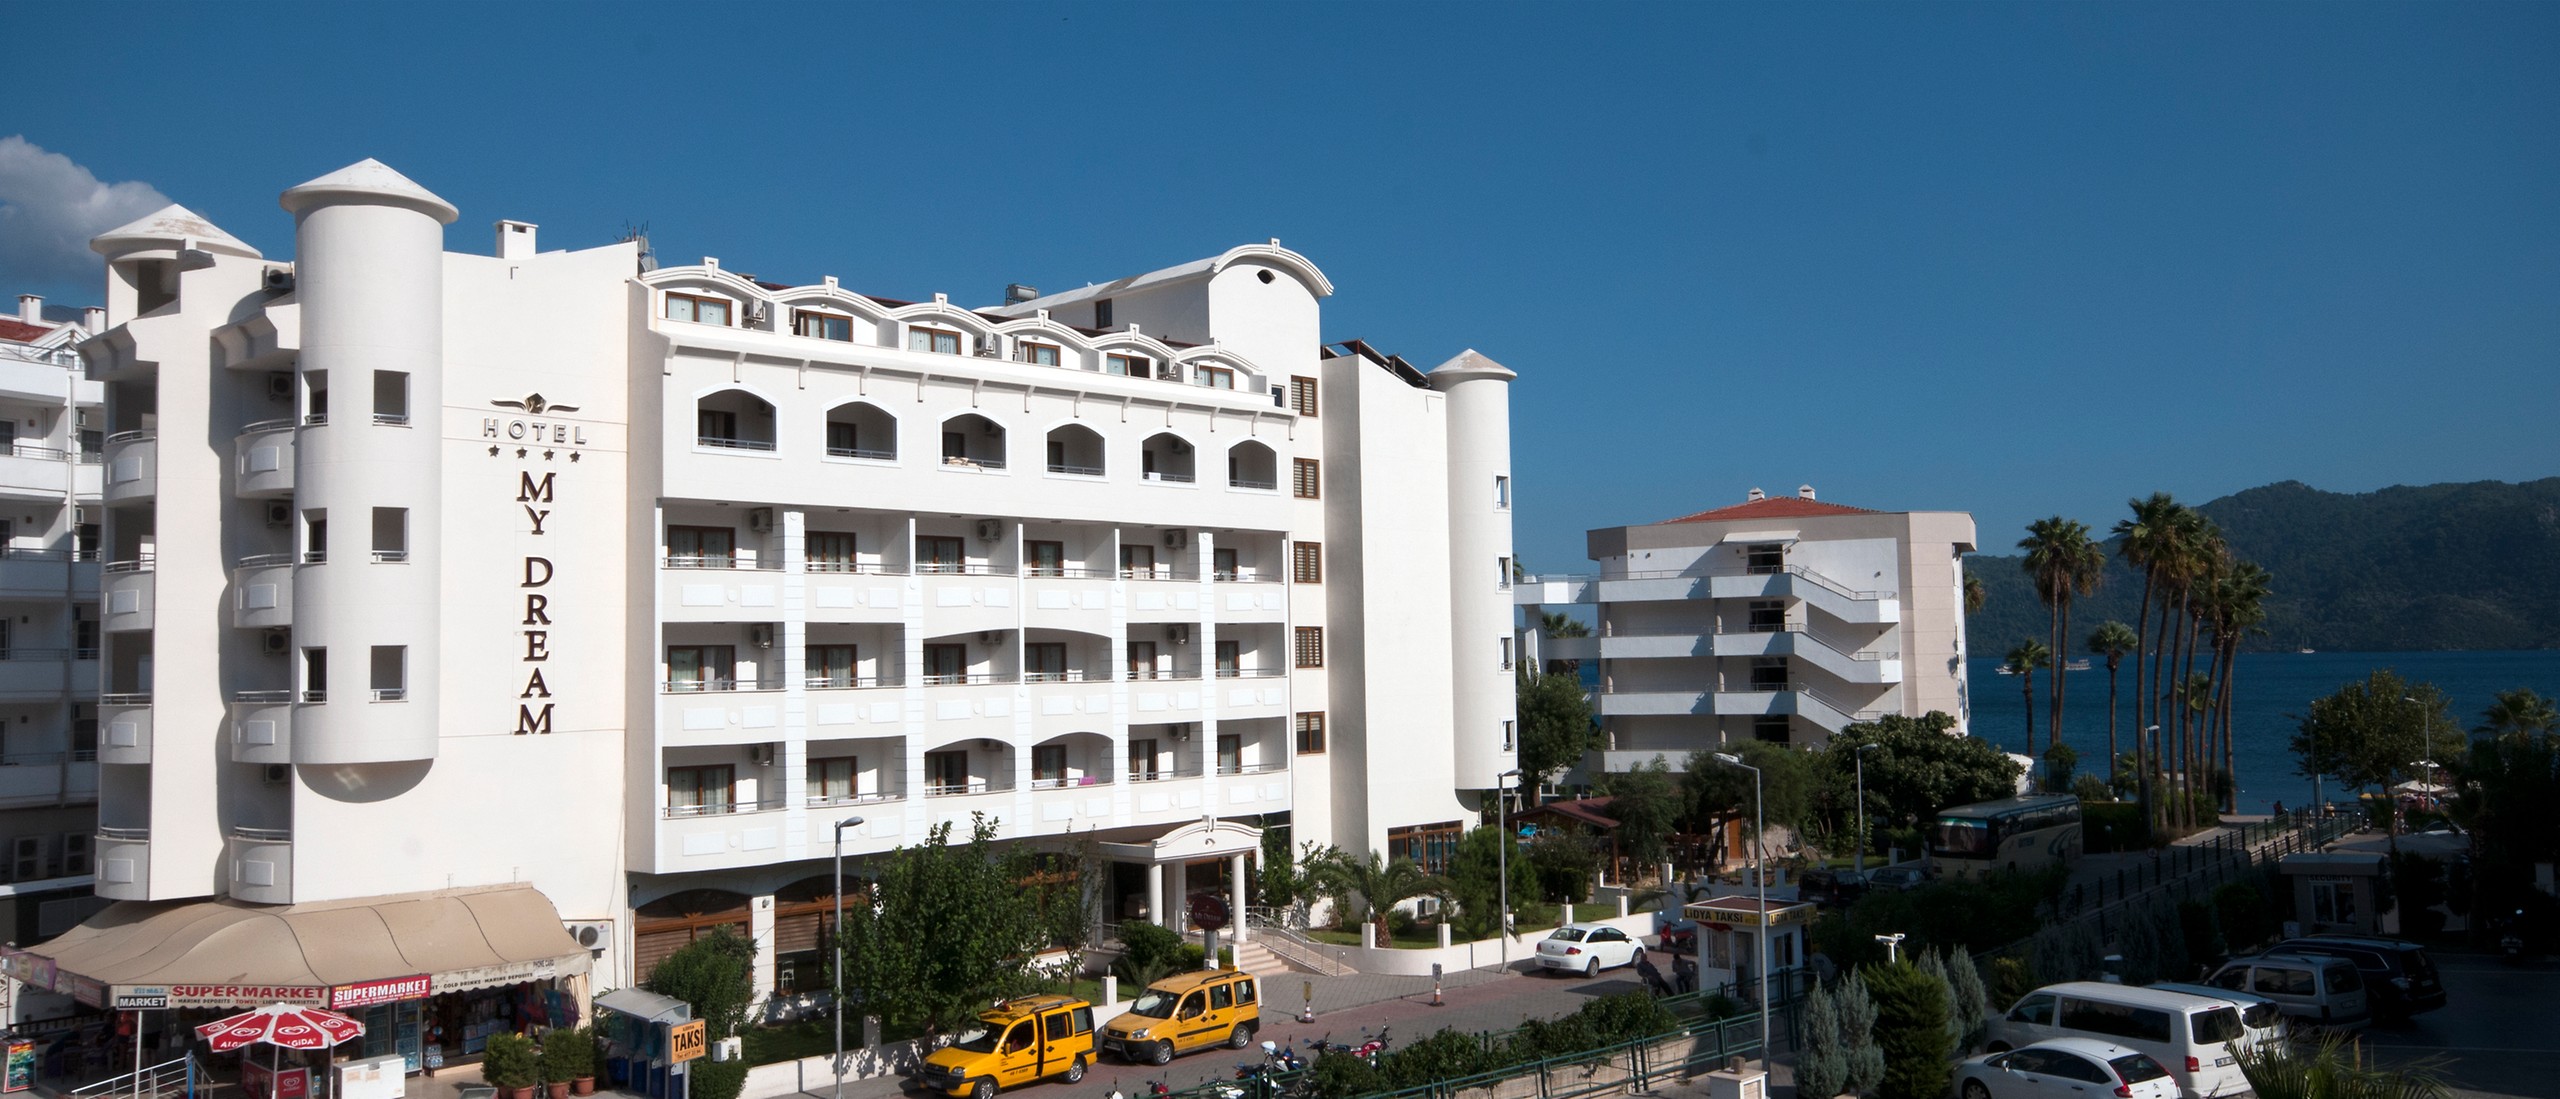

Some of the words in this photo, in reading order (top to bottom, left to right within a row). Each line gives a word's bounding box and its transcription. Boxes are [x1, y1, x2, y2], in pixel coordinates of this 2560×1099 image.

[483, 417, 587, 445] HOTEL
[516, 470, 556, 535] MY
[514, 556, 556, 735] DREAM
[119, 997, 166, 1007] MARKET
[333, 979, 428, 1002] SUPERMARKET
[673, 1023, 704, 1052] TAKSİ
